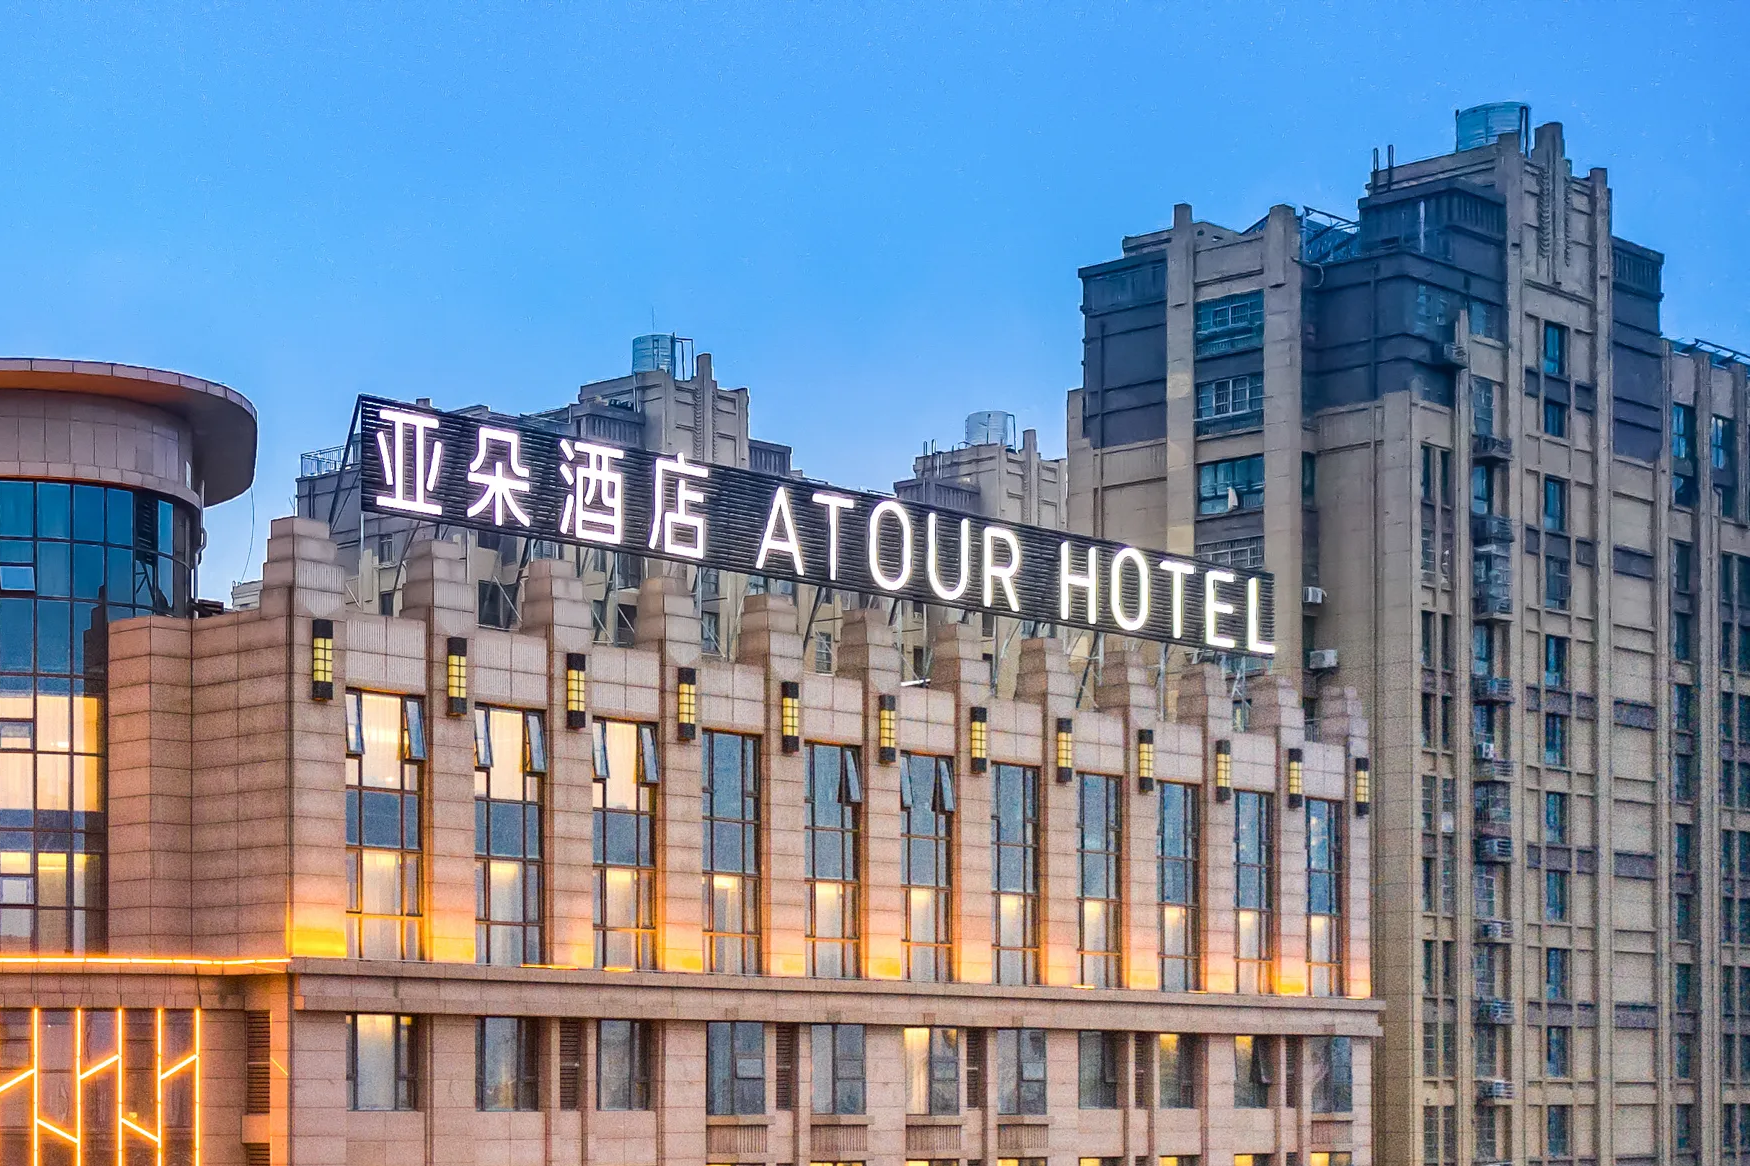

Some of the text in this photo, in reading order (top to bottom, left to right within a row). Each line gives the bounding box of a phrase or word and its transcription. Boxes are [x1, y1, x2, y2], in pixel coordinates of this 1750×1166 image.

[376, 410, 1276, 656] 亚朵酒店 ATOUR HOTEL
